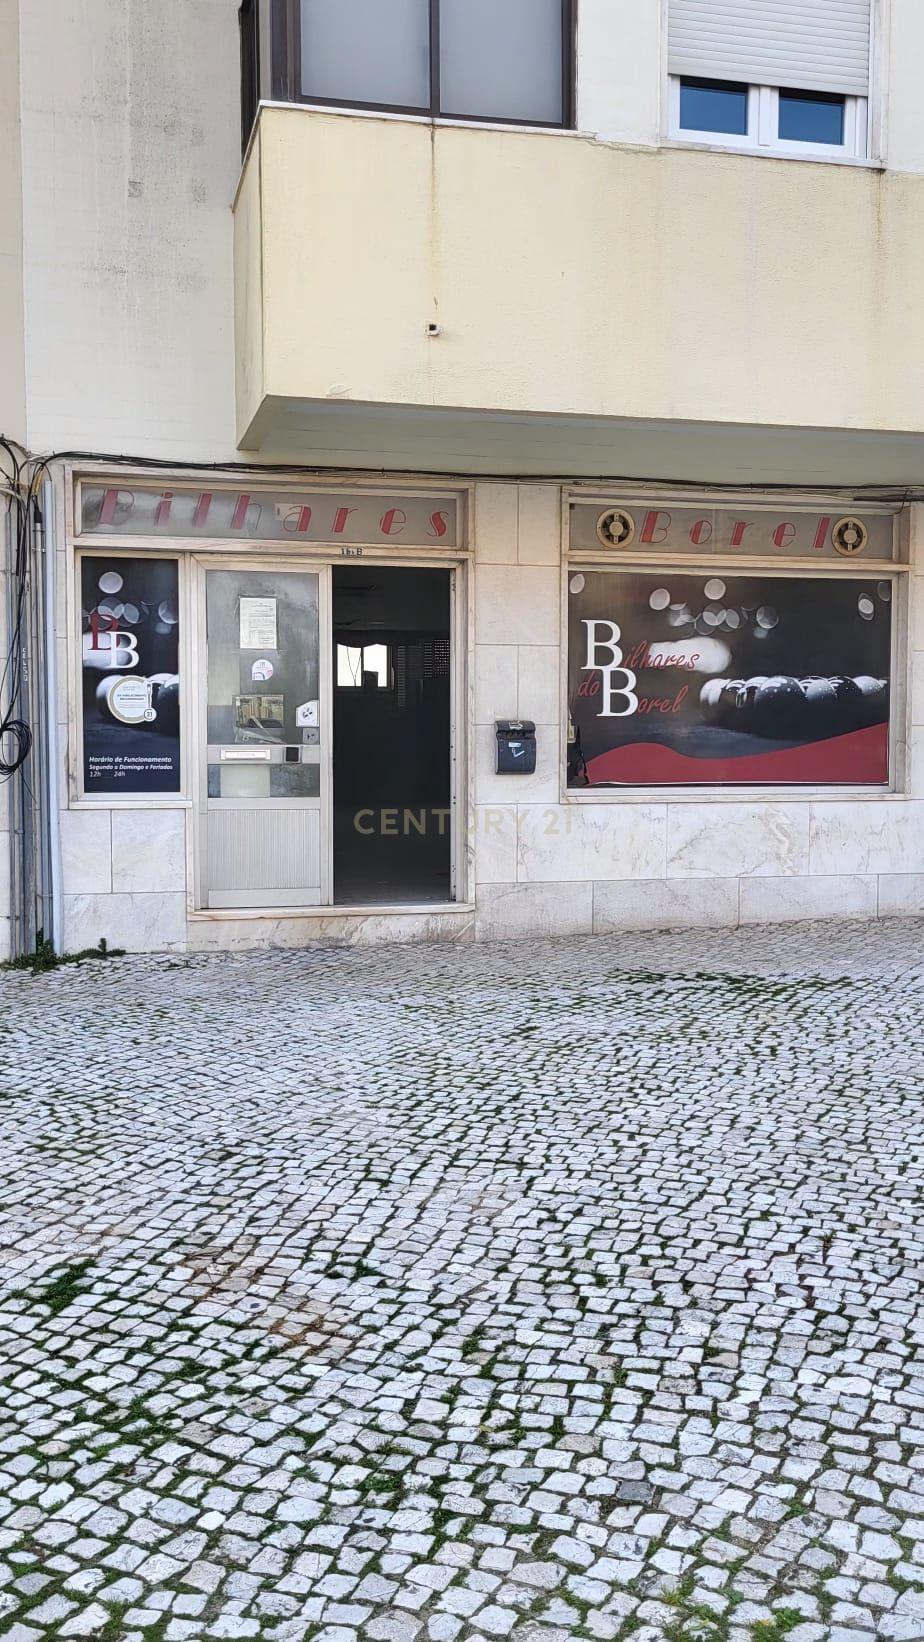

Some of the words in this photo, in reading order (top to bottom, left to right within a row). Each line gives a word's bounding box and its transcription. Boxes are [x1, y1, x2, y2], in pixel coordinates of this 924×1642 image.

[97, 489, 449, 538] Bilhares
[639, 511, 832, 550] Borel
[580, 619, 700, 670] Bilhares
[578, 670, 600, 697] do
[596, 667, 689, 717] Borel
